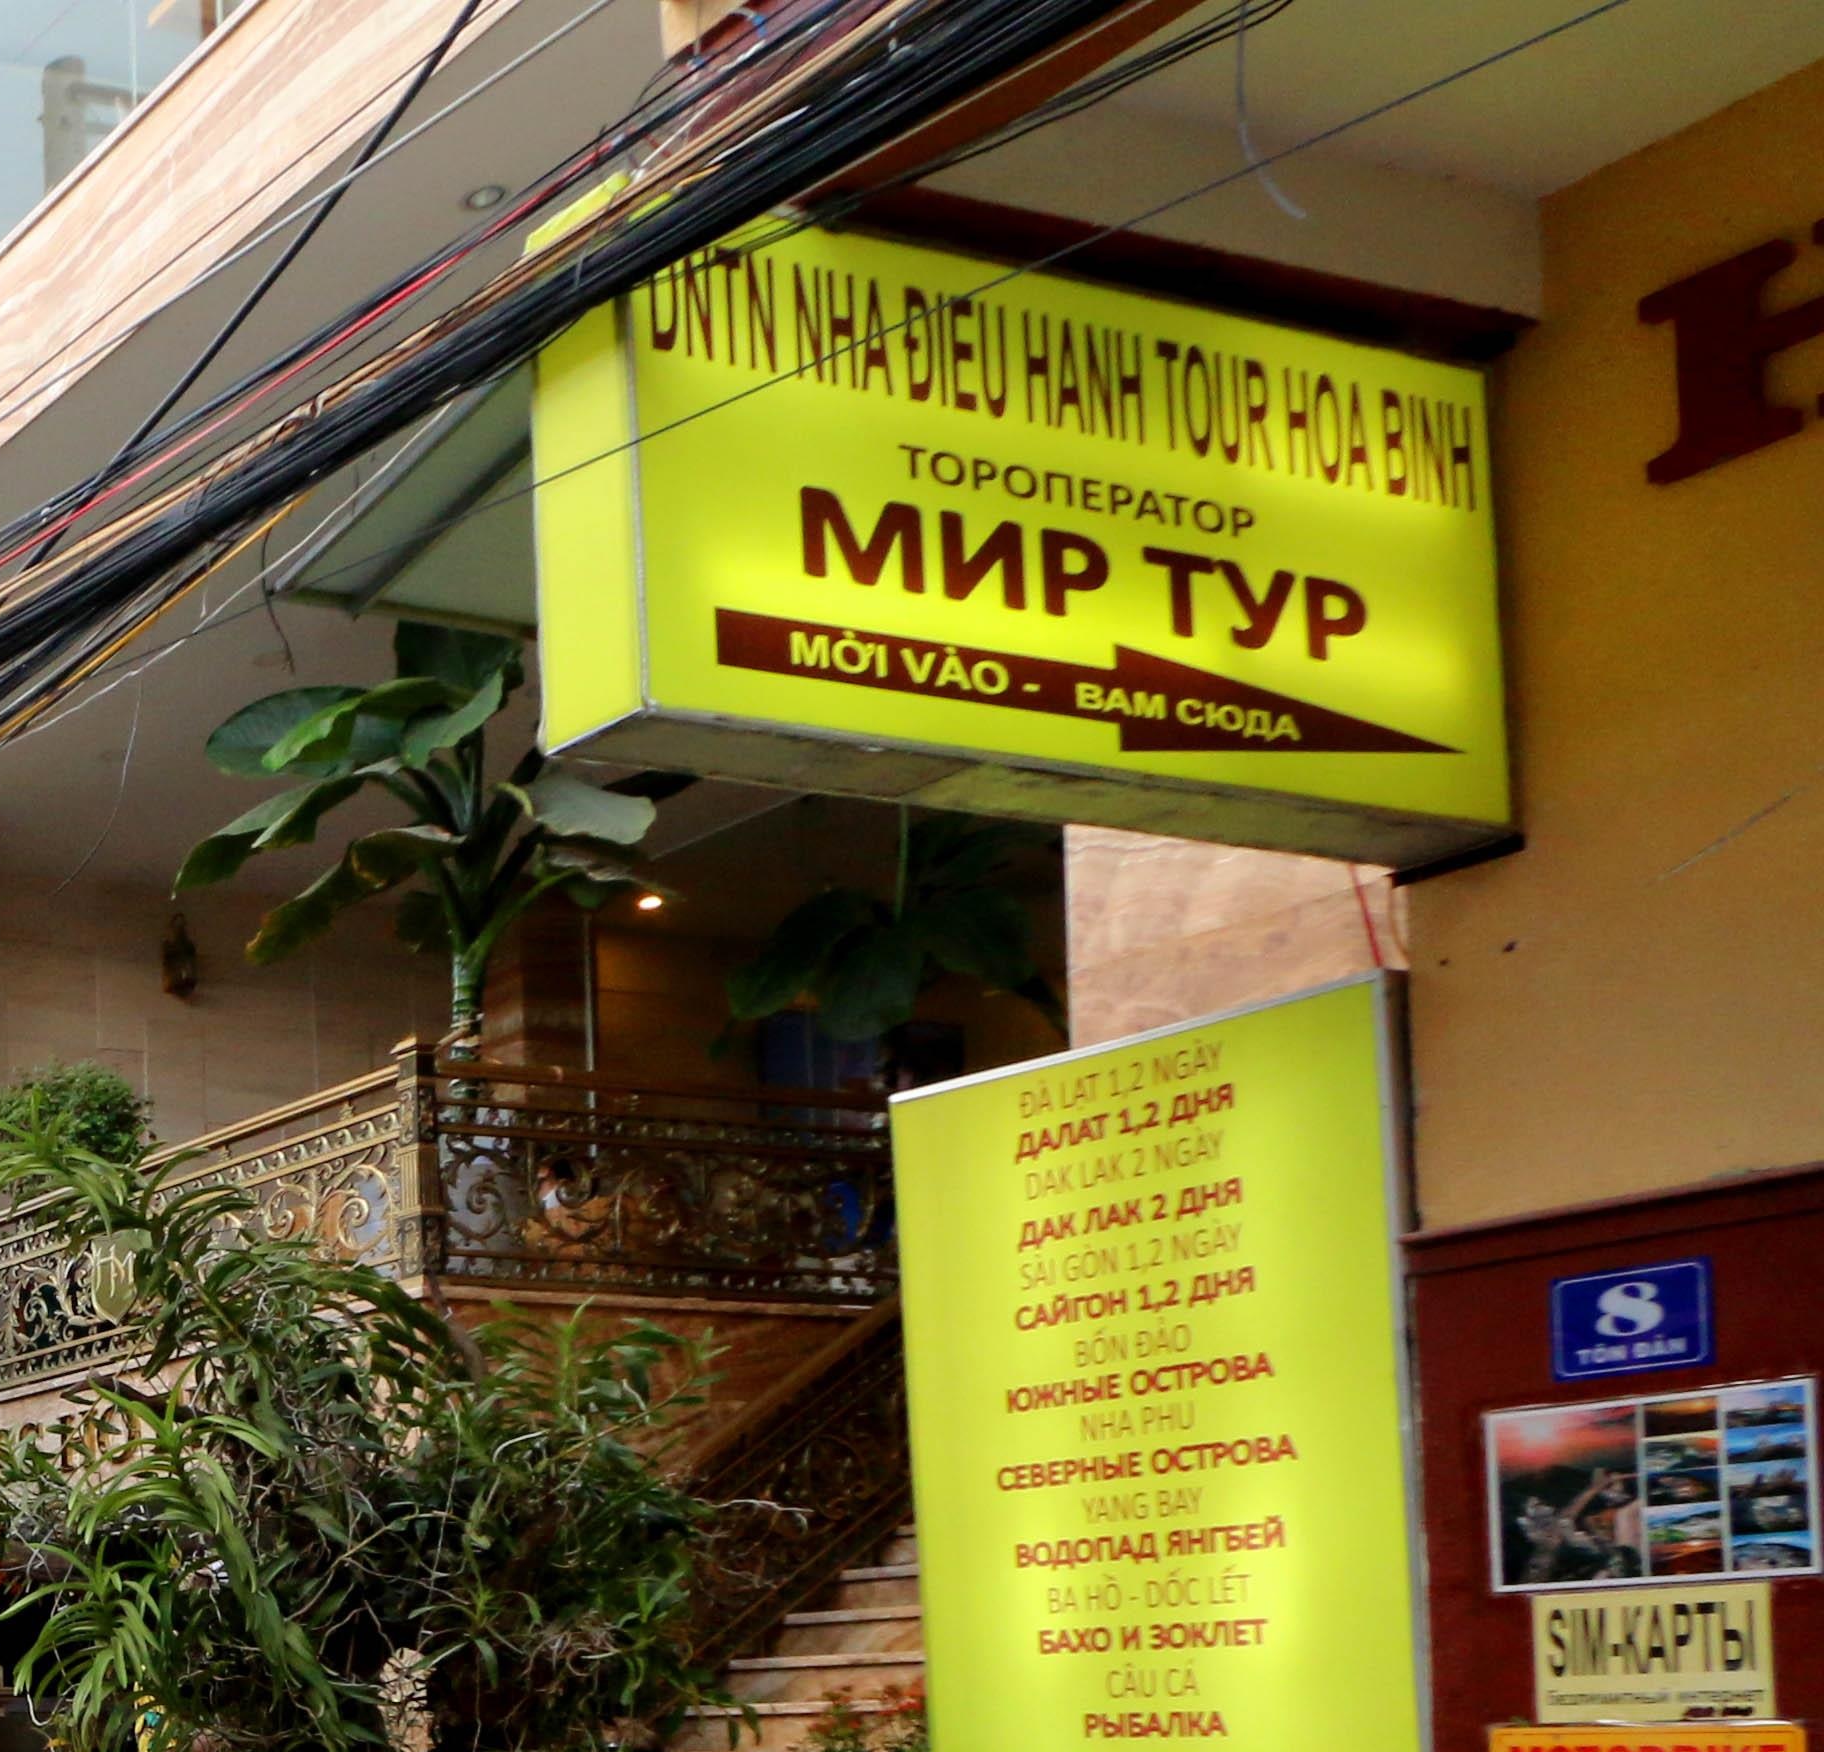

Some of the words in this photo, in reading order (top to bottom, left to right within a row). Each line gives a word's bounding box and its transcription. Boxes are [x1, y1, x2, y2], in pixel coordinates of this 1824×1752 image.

[1153, 338, 1274, 470] TOUR
[898, 444, 1257, 538] ТОРОПЕРАТОР
[799, 484, 1112, 617] МИР
[1142, 546, 1368, 661] ТУР
[1075, 681, 1167, 720] ВАМ
[1175, 698, 1301, 742] СЮДА
[1014, 1113, 1110, 1163] ДАЛАТ
[1168, 1083, 1235, 1128] ДНЯ
[1018, 1212, 1076, 1252] ДАК
[1083, 1196, 1142, 1235] ЛАК
[1150, 1194, 1168, 1221] 2
[1176, 1177, 1242, 1221] ДНЯ
[1014, 1288, 1128, 1332] САЙГОН
[1188, 1265, 1255, 1309] ДНЯ
[1595, 1282, 1664, 1336] 8
[1006, 1372, 1121, 1414] ЮЖНЫЕ
[1130, 1352, 1274, 1396] ОСТРОВА
[997, 1448, 1143, 1491] СЕВЕРНЫЕ
[1152, 1434, 1298, 1475] ОСТРОВА
[1015, 1532, 1159, 1571] ВОДОПАД
[1167, 1515, 1287, 1554] ЯНГБЕЙ
[1038, 1626, 1112, 1655] БАХО
[1121, 1625, 1142, 1649] И
[1151, 1618, 1268, 1650] ЗОКЛЕТ
[1084, 1712, 1228, 1738] РЫБАЛКА
